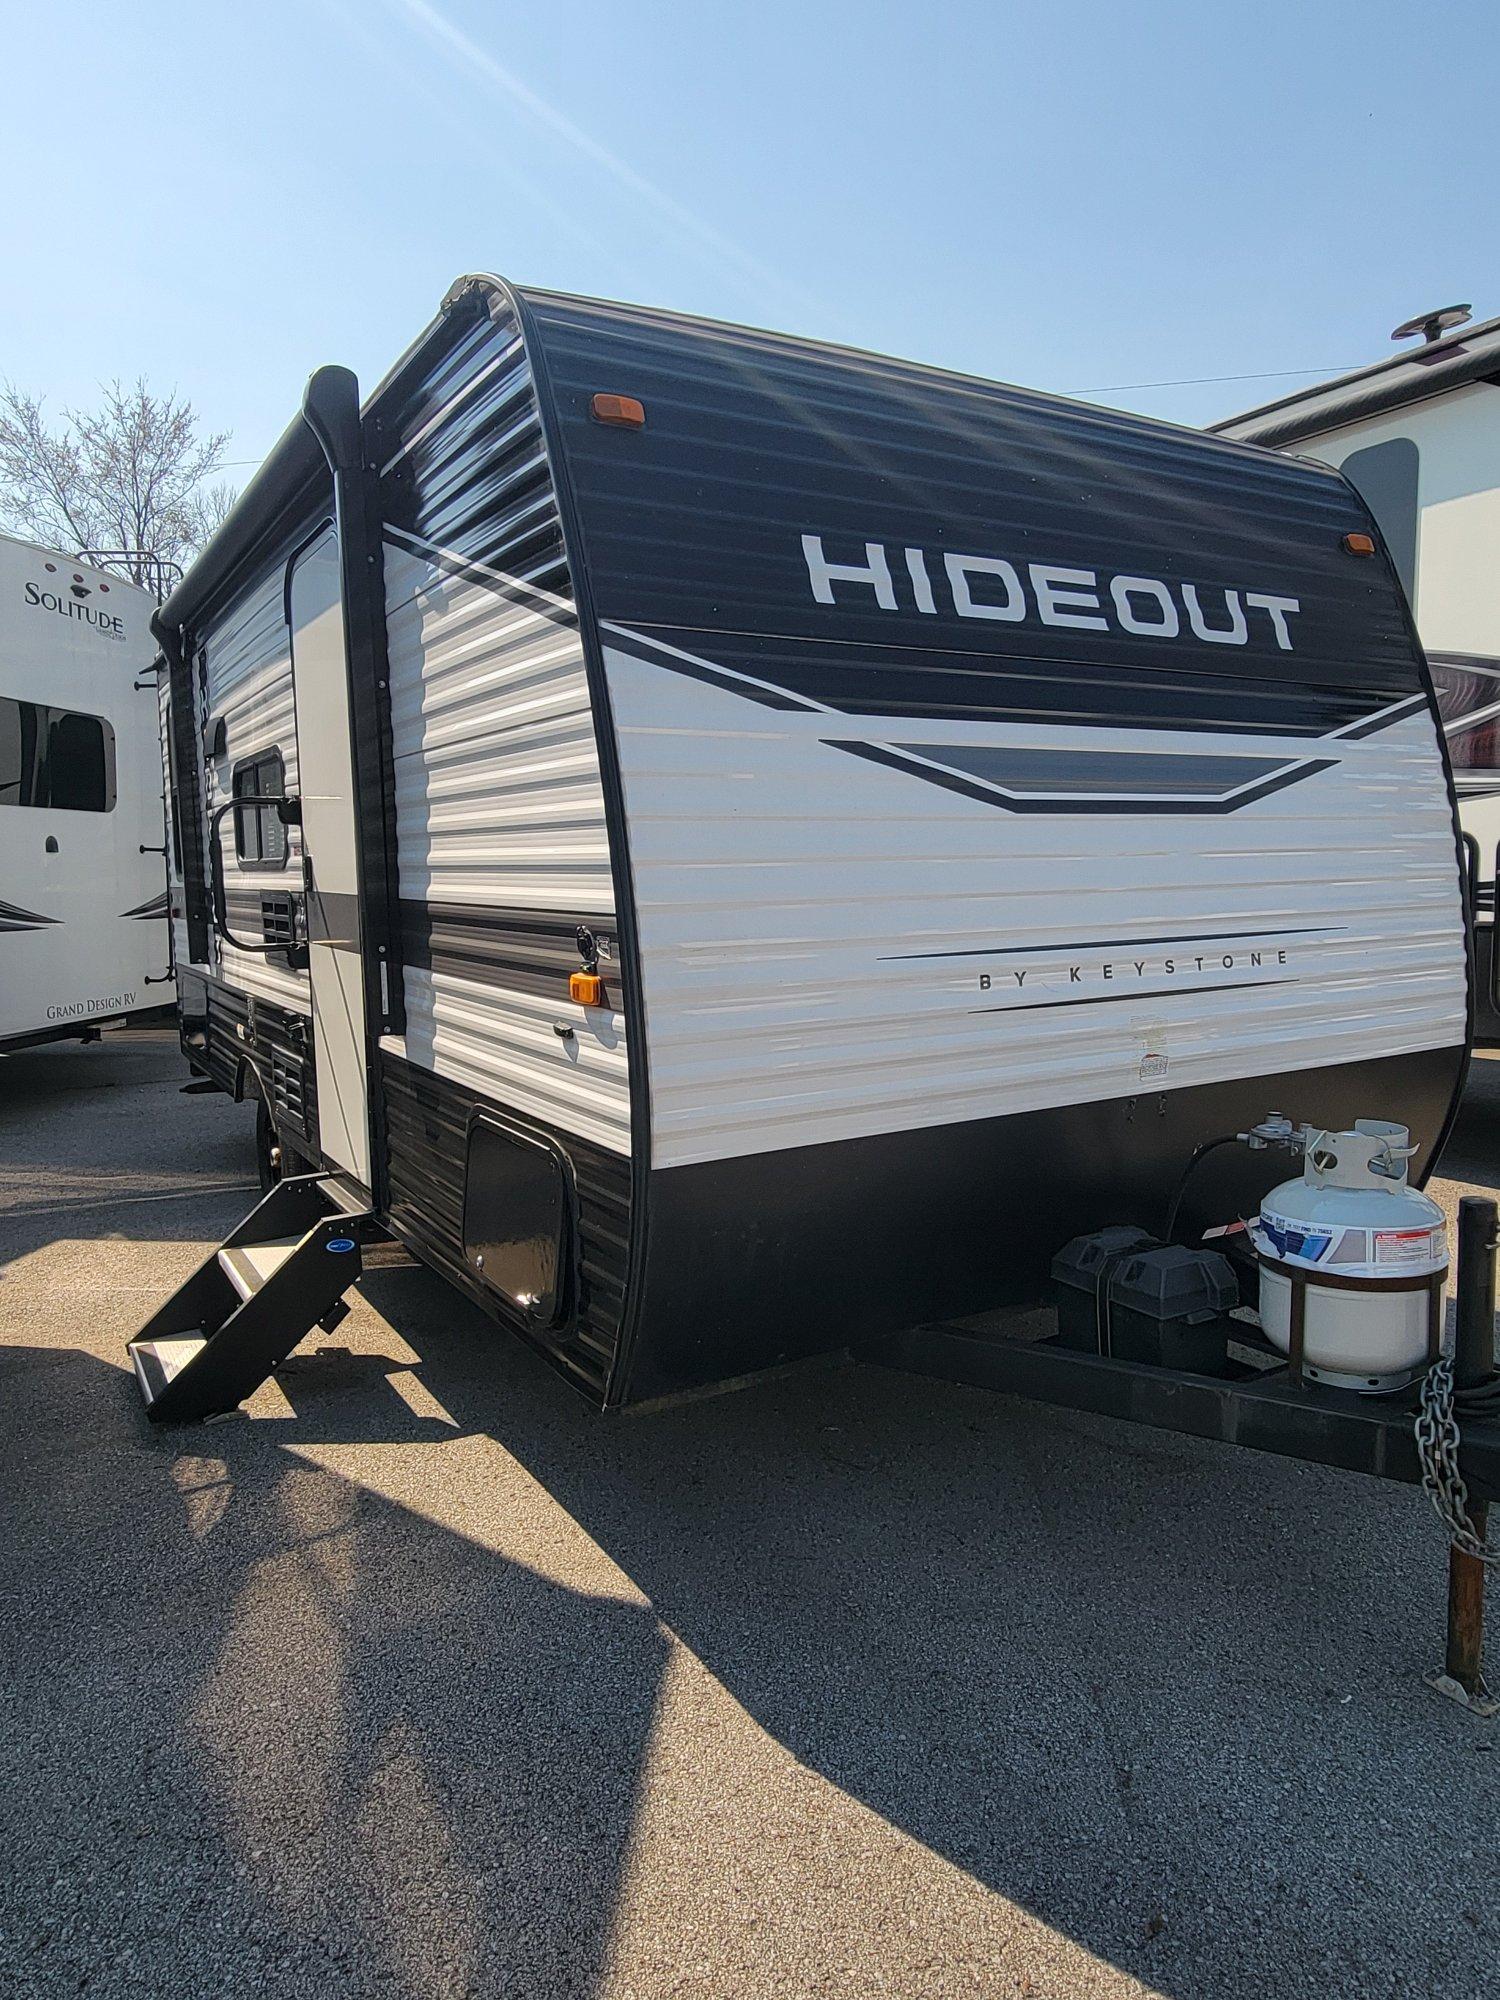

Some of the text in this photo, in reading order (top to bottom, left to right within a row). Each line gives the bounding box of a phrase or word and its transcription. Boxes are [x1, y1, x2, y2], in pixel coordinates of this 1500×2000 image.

[25, 582, 123, 634] SOLITUDE
[801, 534, 1300, 650] HIDEOUT
[979, 950, 1287, 990] BY KEYSTONE
[46, 992, 137, 1019] GRAND DESIGN RV
